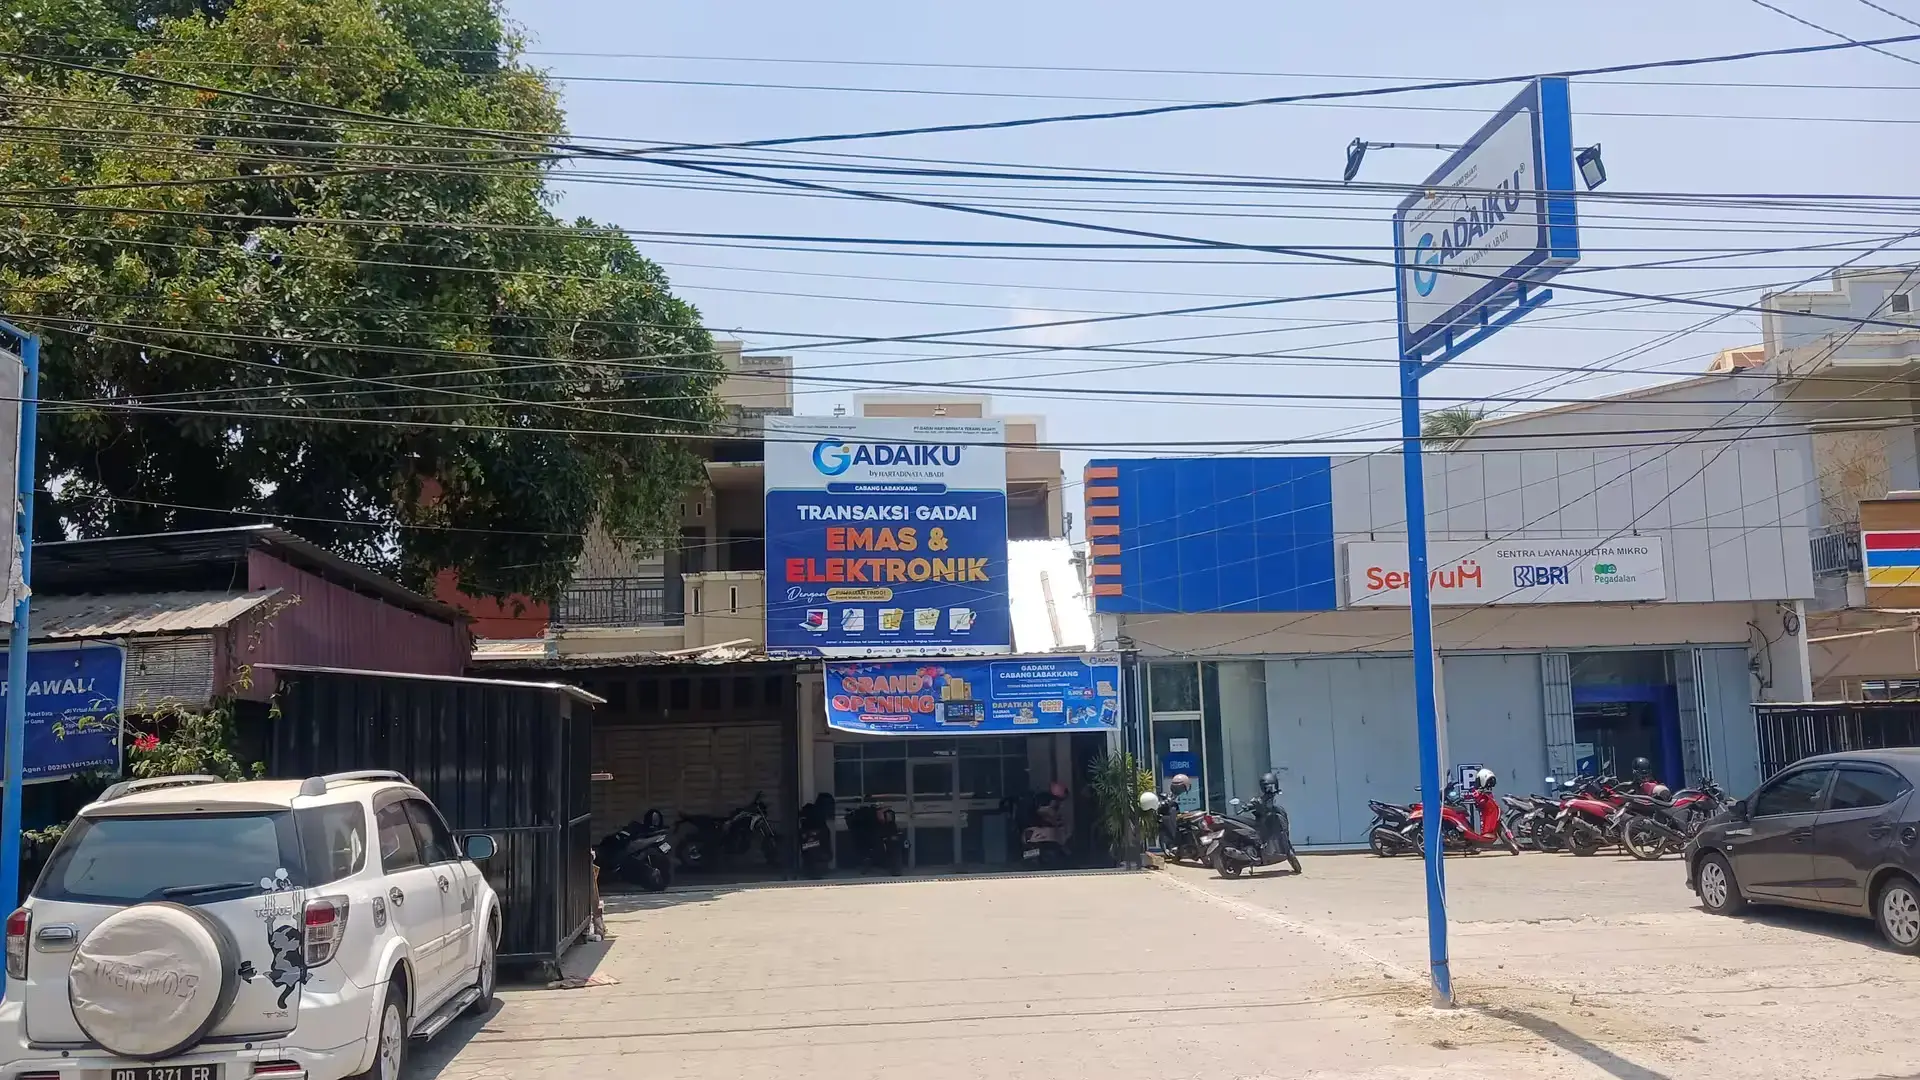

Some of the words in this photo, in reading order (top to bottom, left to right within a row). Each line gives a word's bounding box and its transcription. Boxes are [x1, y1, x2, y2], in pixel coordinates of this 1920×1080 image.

[1414, 170, 1519, 297] GADAIKU
[812, 437, 962, 476] GADAIKU
[869, 470, 878, 478] by
[797, 505, 909, 521] TRANSAKSI
[916, 505, 977, 521] GADAI
[826, 527, 918, 551] EMAS
[927, 527, 949, 551] &
[1497, 550, 1536, 558] SENTRA
[1585, 548, 1615, 556] ULTRA
[1617, 547, 1648, 555] MIKRO
[785, 557, 990, 582] ELEKTRONIK
[1535, 566, 1569, 585] BRI
[786, 586, 827, 603] Dengan
[841, 675, 924, 694] GRAND
[832, 695, 935, 713] OPENING
[1462, 769, 1478, 789] P
[254, 906, 292, 918] TERIOS
